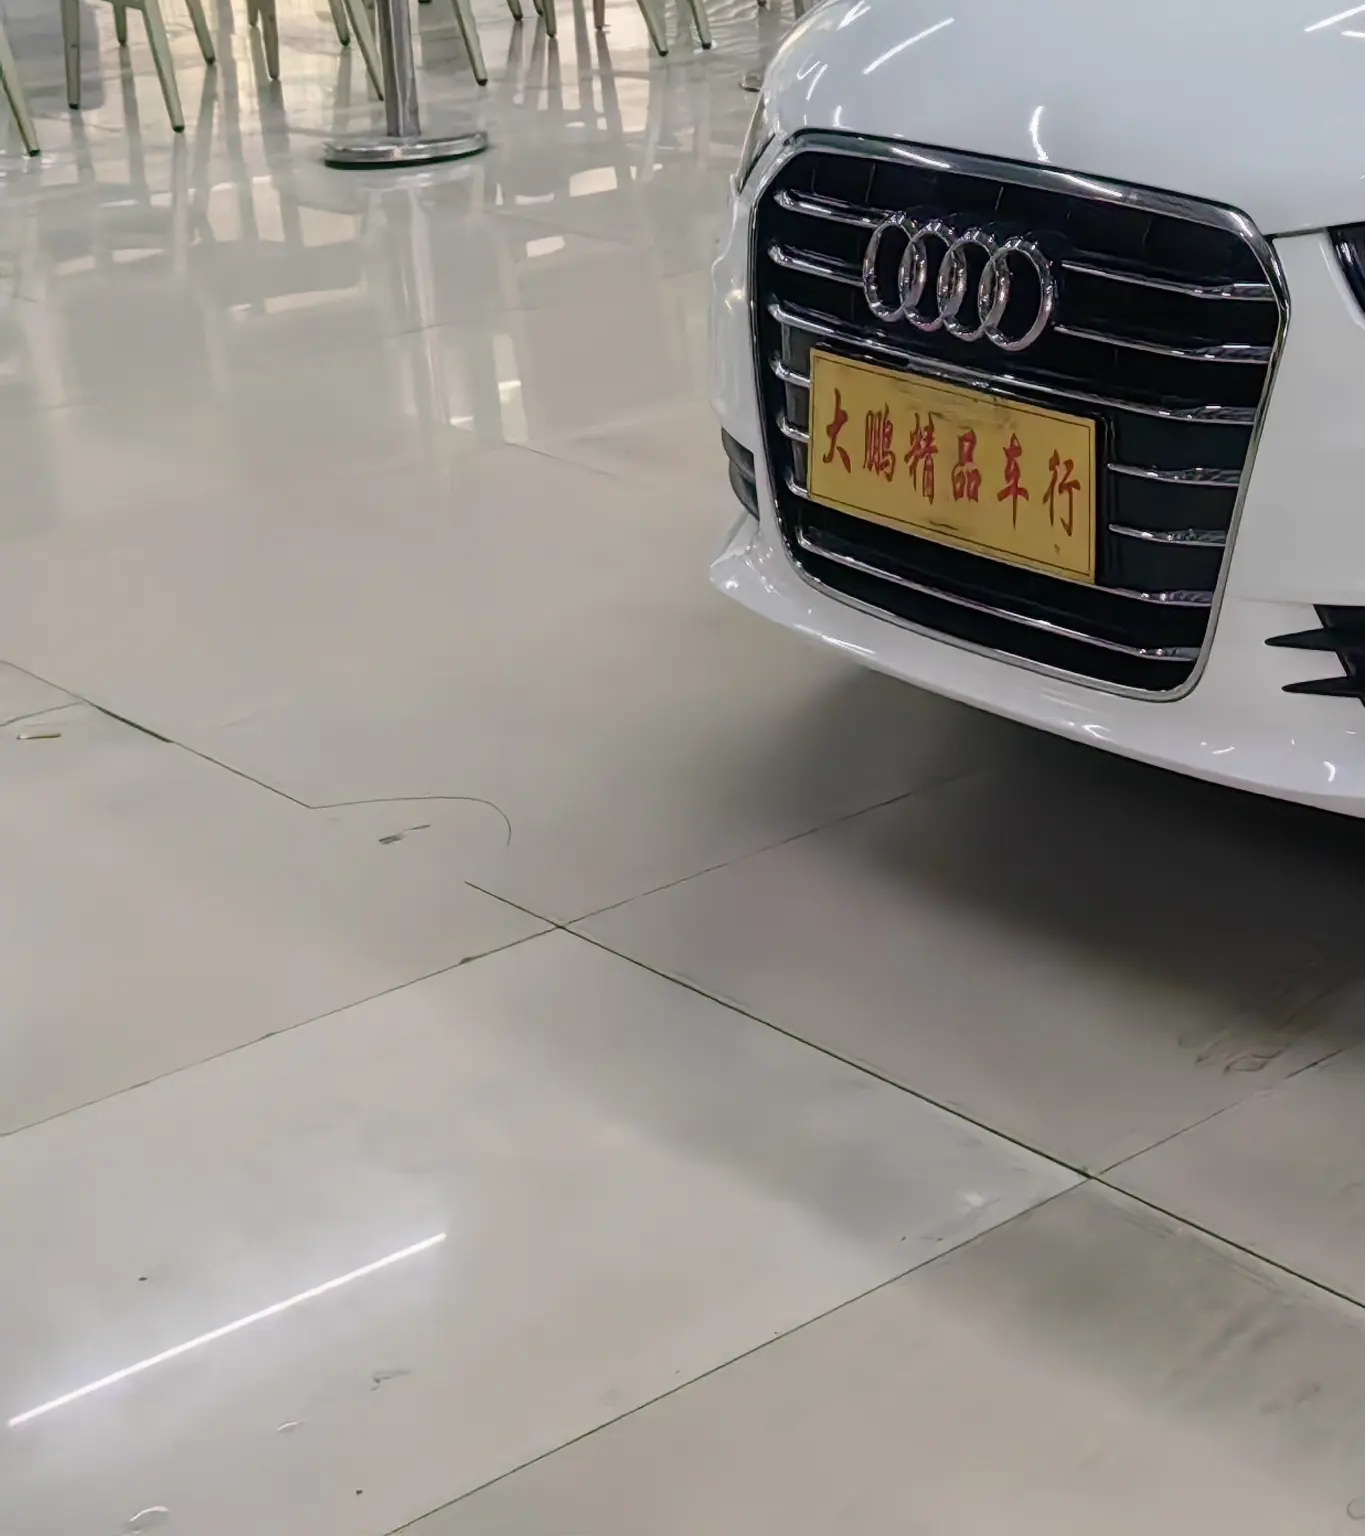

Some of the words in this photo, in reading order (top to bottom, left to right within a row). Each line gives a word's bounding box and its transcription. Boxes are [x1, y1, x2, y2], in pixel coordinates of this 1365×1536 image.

[823, 386, 1081, 537] 大鹏精品车行
